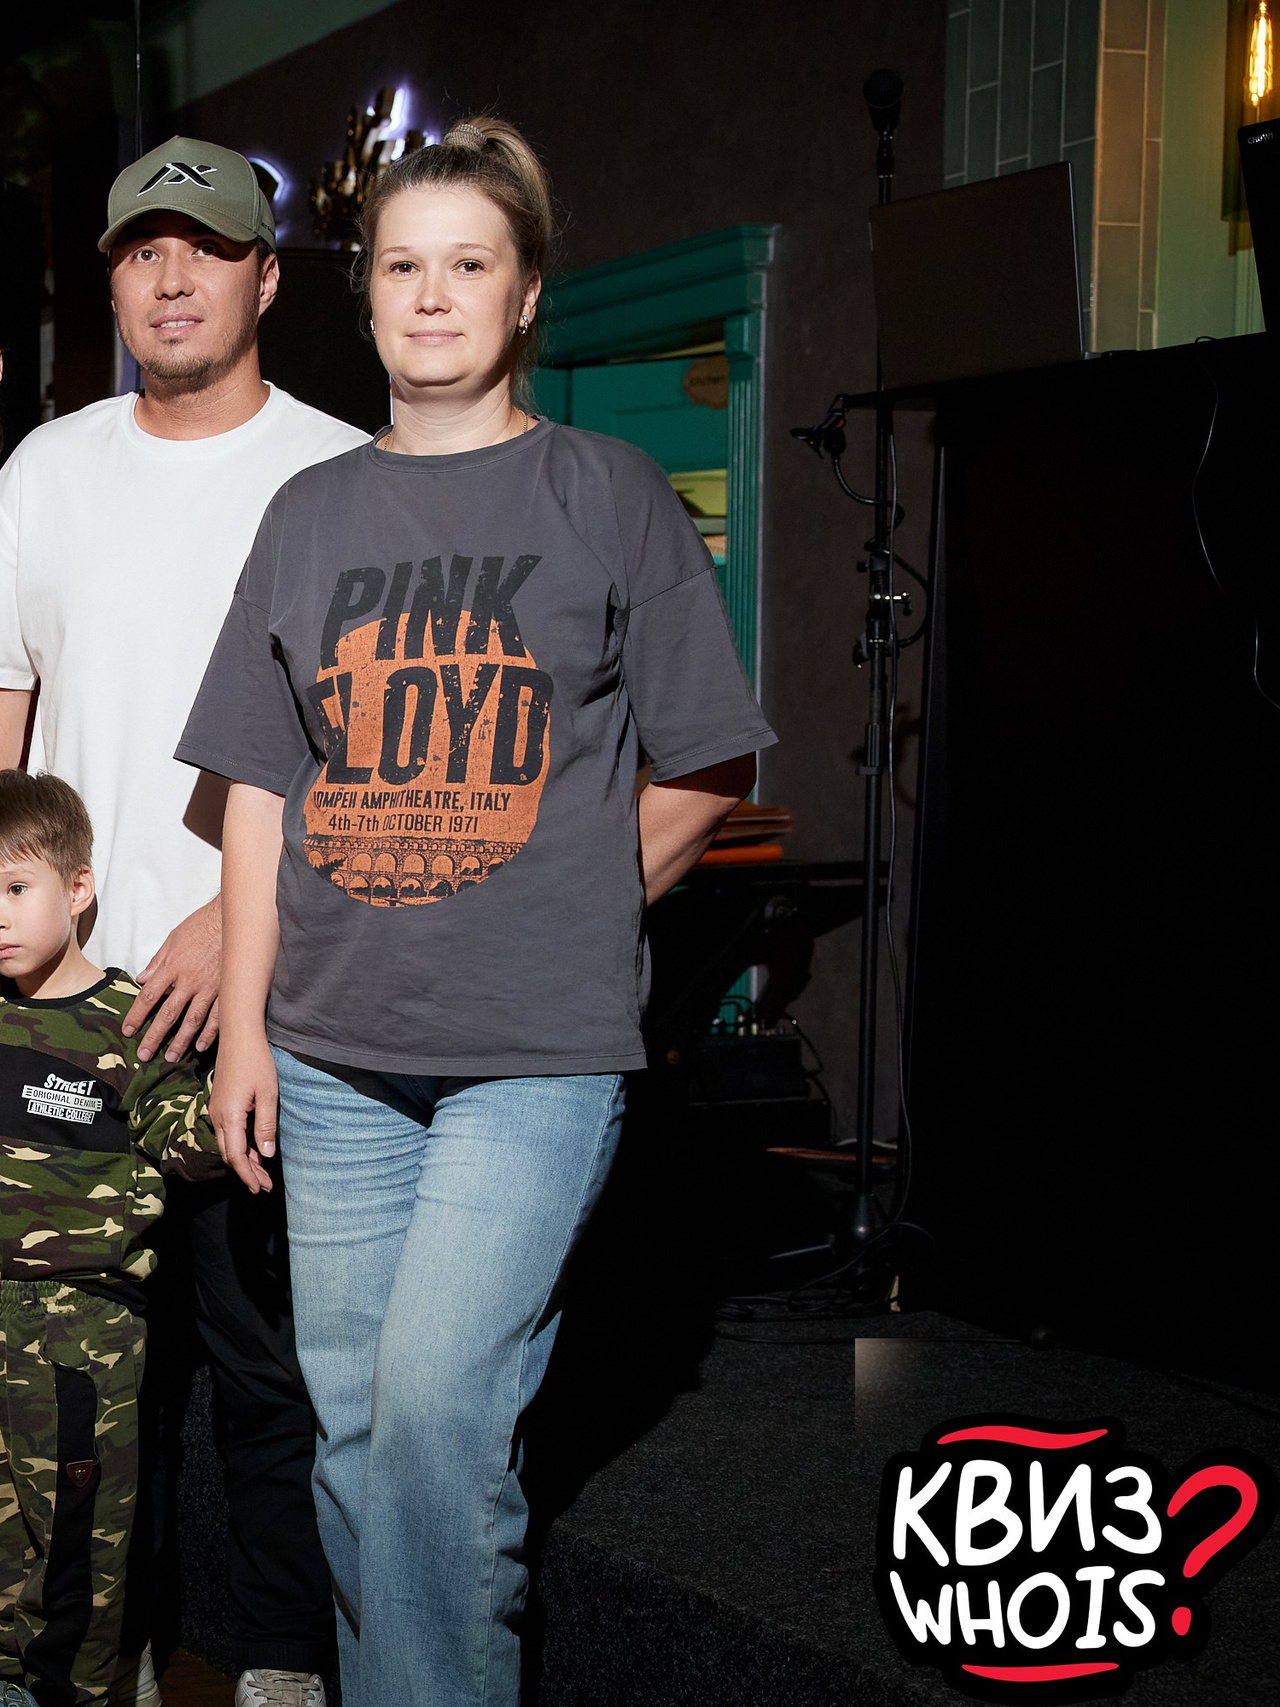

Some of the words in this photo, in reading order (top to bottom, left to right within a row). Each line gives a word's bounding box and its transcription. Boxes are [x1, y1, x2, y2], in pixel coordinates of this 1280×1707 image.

[320, 554, 543, 670] PINK
[360, 790, 465, 812] AMPHITHEATRE,
[469, 792, 511, 811] ITALY
[328, 814, 379, 832] 4th-7th
[382, 814, 443, 832] OCTOBER
[448, 816, 478, 833] 1971
[44, 1073, 96, 1096] STREET
[32, 1089, 71, 1104] ORIGINAL
[73, 1097, 96, 1109] DENIM
[30, 1102, 64, 1117] ATHLETIC
[65, 1109, 92, 1122] COLLEGE
